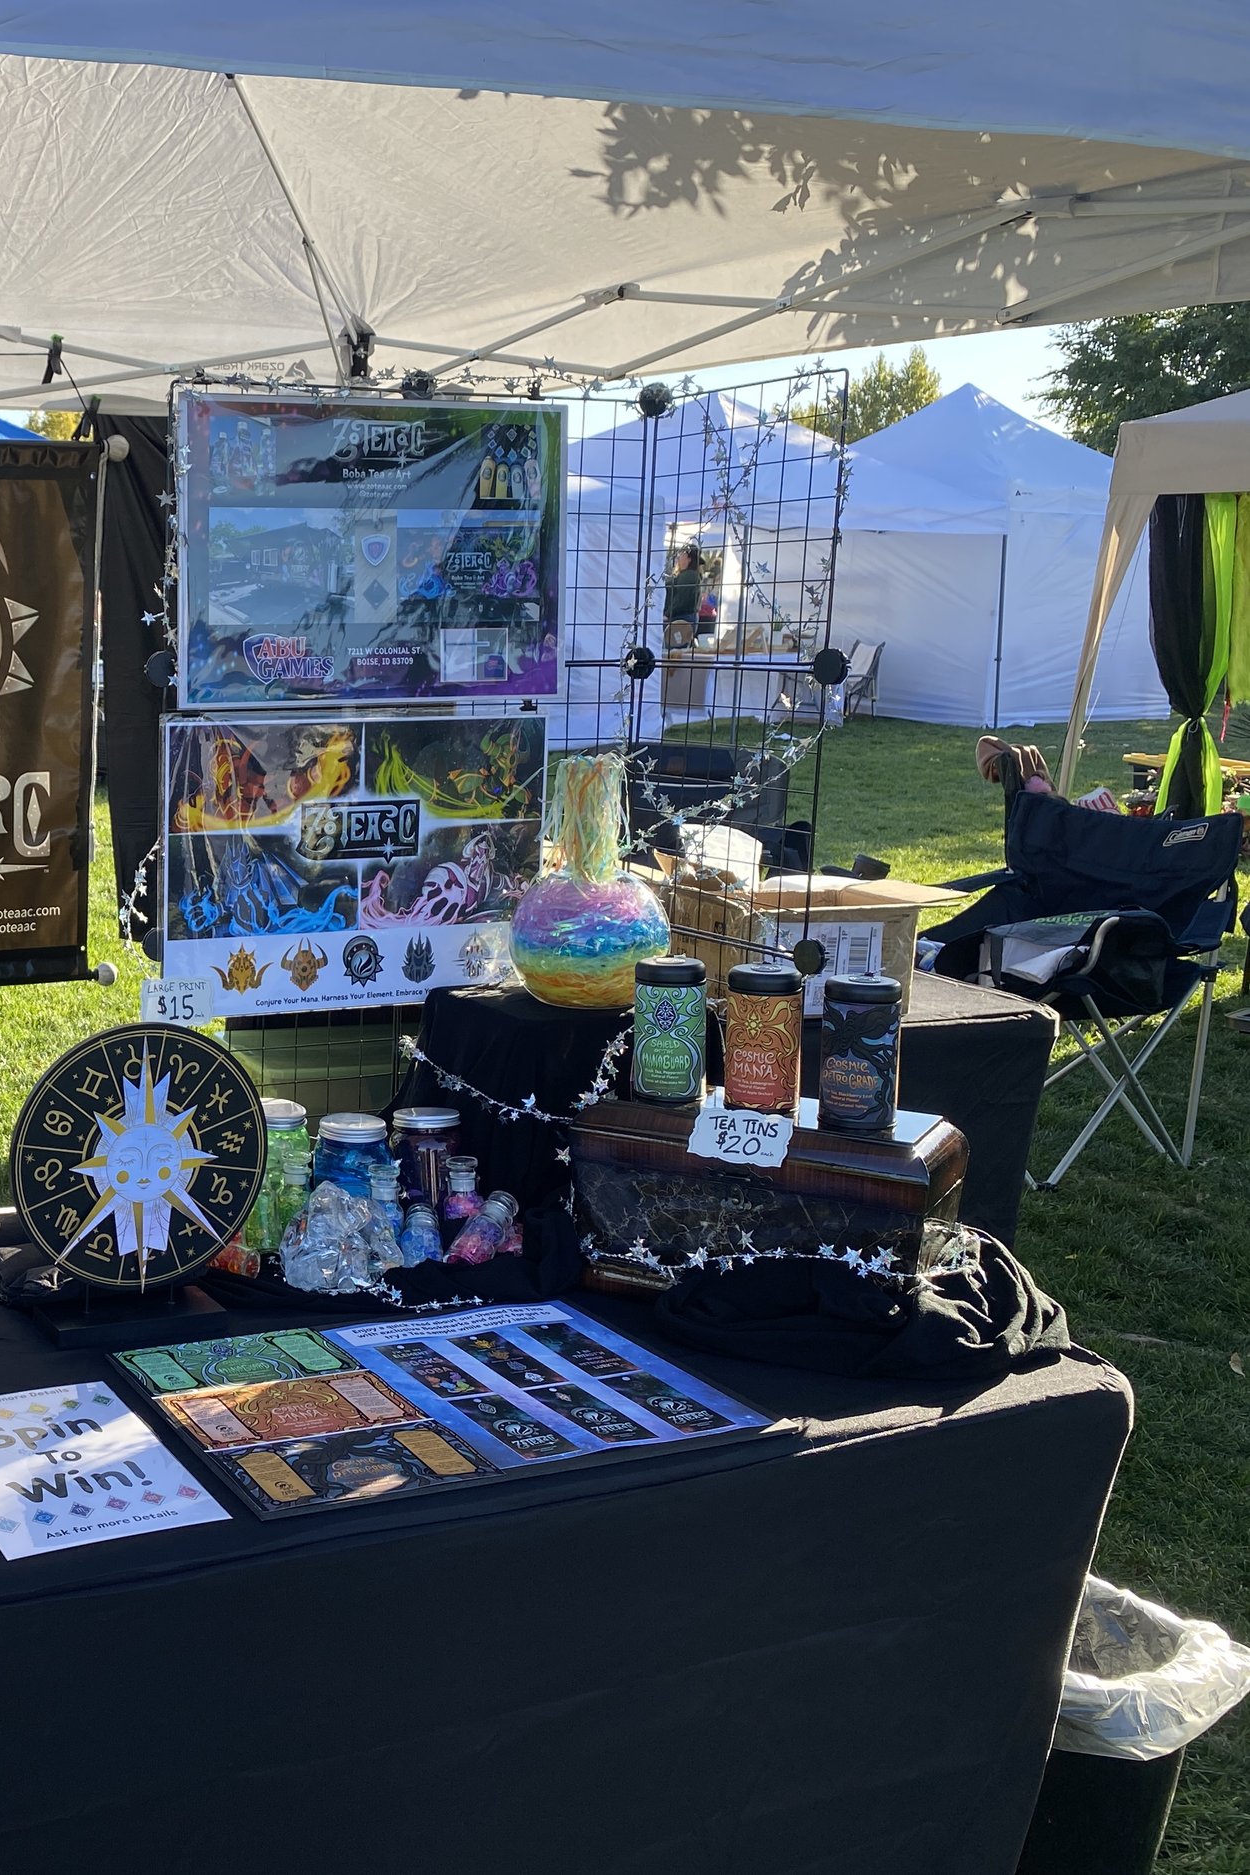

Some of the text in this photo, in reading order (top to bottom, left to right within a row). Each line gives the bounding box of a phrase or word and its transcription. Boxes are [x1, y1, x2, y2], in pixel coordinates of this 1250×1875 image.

[343, 468, 411, 479] Boba Tea Art
[257, 636, 307, 659] ABU
[347, 646, 423, 655] 7211 W COLONIAL ST.
[257, 655, 335, 680] GAMES
[356, 658, 381, 667] BOISE,
[392, 657, 414, 665] 83709
[147, 981, 207, 994] LARGE PRINT
[157, 994, 194, 1020] $15
[255, 998, 282, 1007] Conjure
[283, 997, 299, 1005] Your
[321, 994, 349, 1002] Harness
[395, 989, 423, 997] Embrace
[650, 1039, 681, 1049] SHIELD
[733, 1049, 777, 1065] COSMIC
[826, 1057, 870, 1074] COSMIC
[731, 1061, 778, 1081] MANA
[709, 1116, 779, 1138] TEA TINS
[716, 1131, 761, 1156] $20
[36, 1450, 82, 1465] To
[6, 1460, 153, 1504] Win!
[46, 1509, 178, 1540] Ask for more Details
